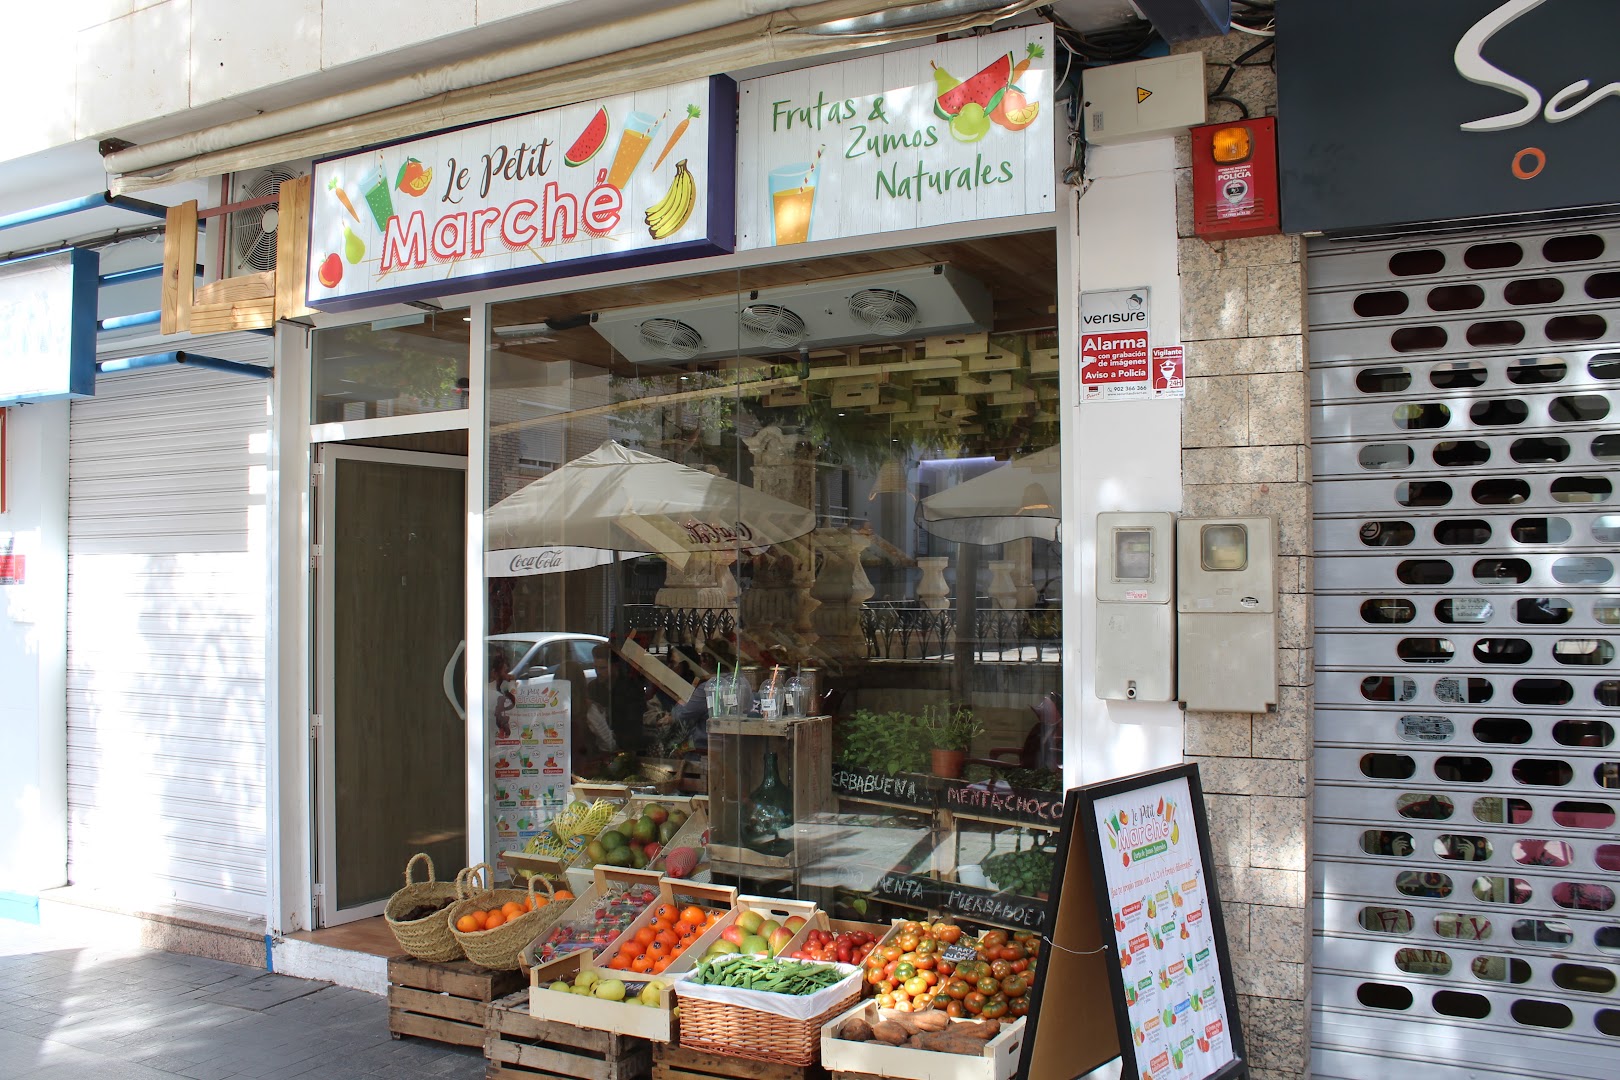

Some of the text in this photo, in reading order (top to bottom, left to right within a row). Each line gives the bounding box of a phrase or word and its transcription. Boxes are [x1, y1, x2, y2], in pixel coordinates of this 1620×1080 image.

[772, 91, 889, 132] Frutas &
[845, 125, 938, 159] Zumos
[441, 137, 554, 204] Le Petit
[876, 153, 1013, 202] Naturales
[378, 168, 624, 275] Marché
[1083, 311, 1146, 324] verisure
[1083, 337, 1147, 351] Alarma
[1112, 351, 1146, 359] grabación
[1153, 349, 1182, 357] Vigilante
[1110, 359, 1146, 368] imágenes
[1085, 371, 1108, 379] Aviso
[1169, 379, 1181, 387] 24H
